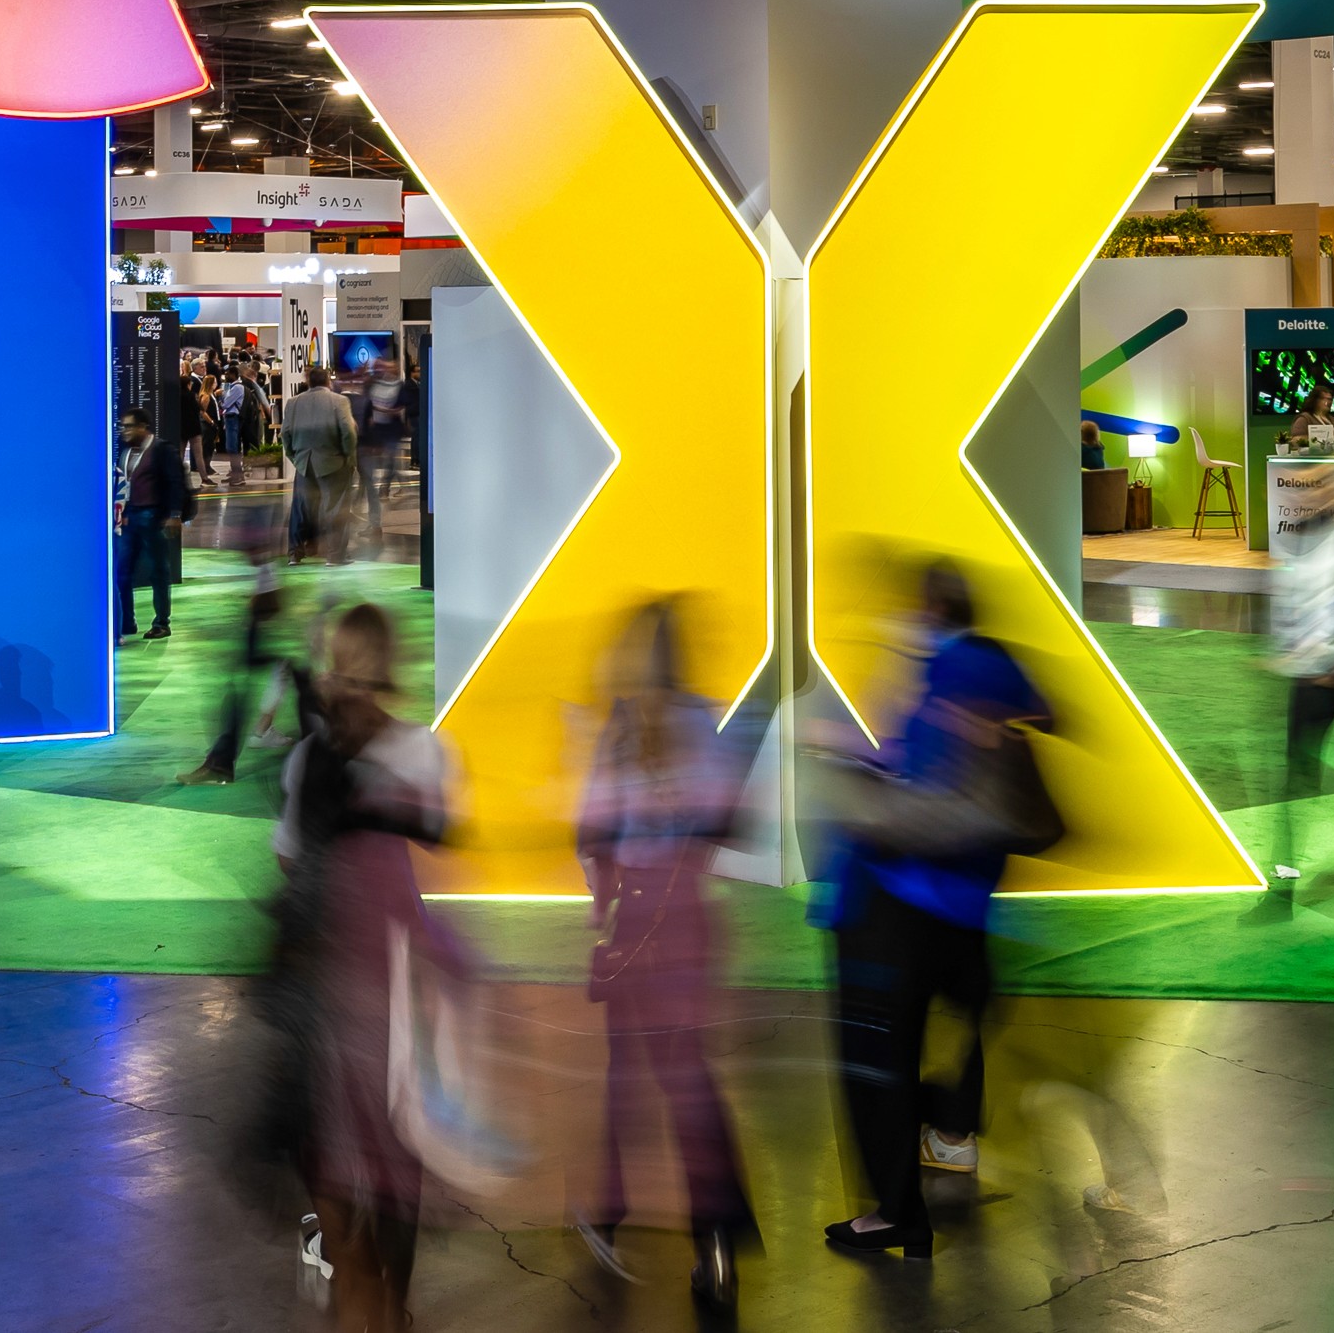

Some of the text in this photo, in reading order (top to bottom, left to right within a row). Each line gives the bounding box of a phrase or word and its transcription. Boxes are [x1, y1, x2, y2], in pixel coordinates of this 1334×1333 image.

[172, 150, 191, 158] CC36
[112, 195, 147, 207] SADA
[257, 190, 299, 209] Insight
[319, 196, 363, 208] SADA
[346, 279, 372, 288] cognizant
[137, 316, 160, 324] Google
[290, 298, 309, 339] The
[144, 323, 162, 331] Cloud
[138, 330, 160, 340] Next 25
[290, 343, 311, 374] new
[1278, 505, 1291, 517] To
